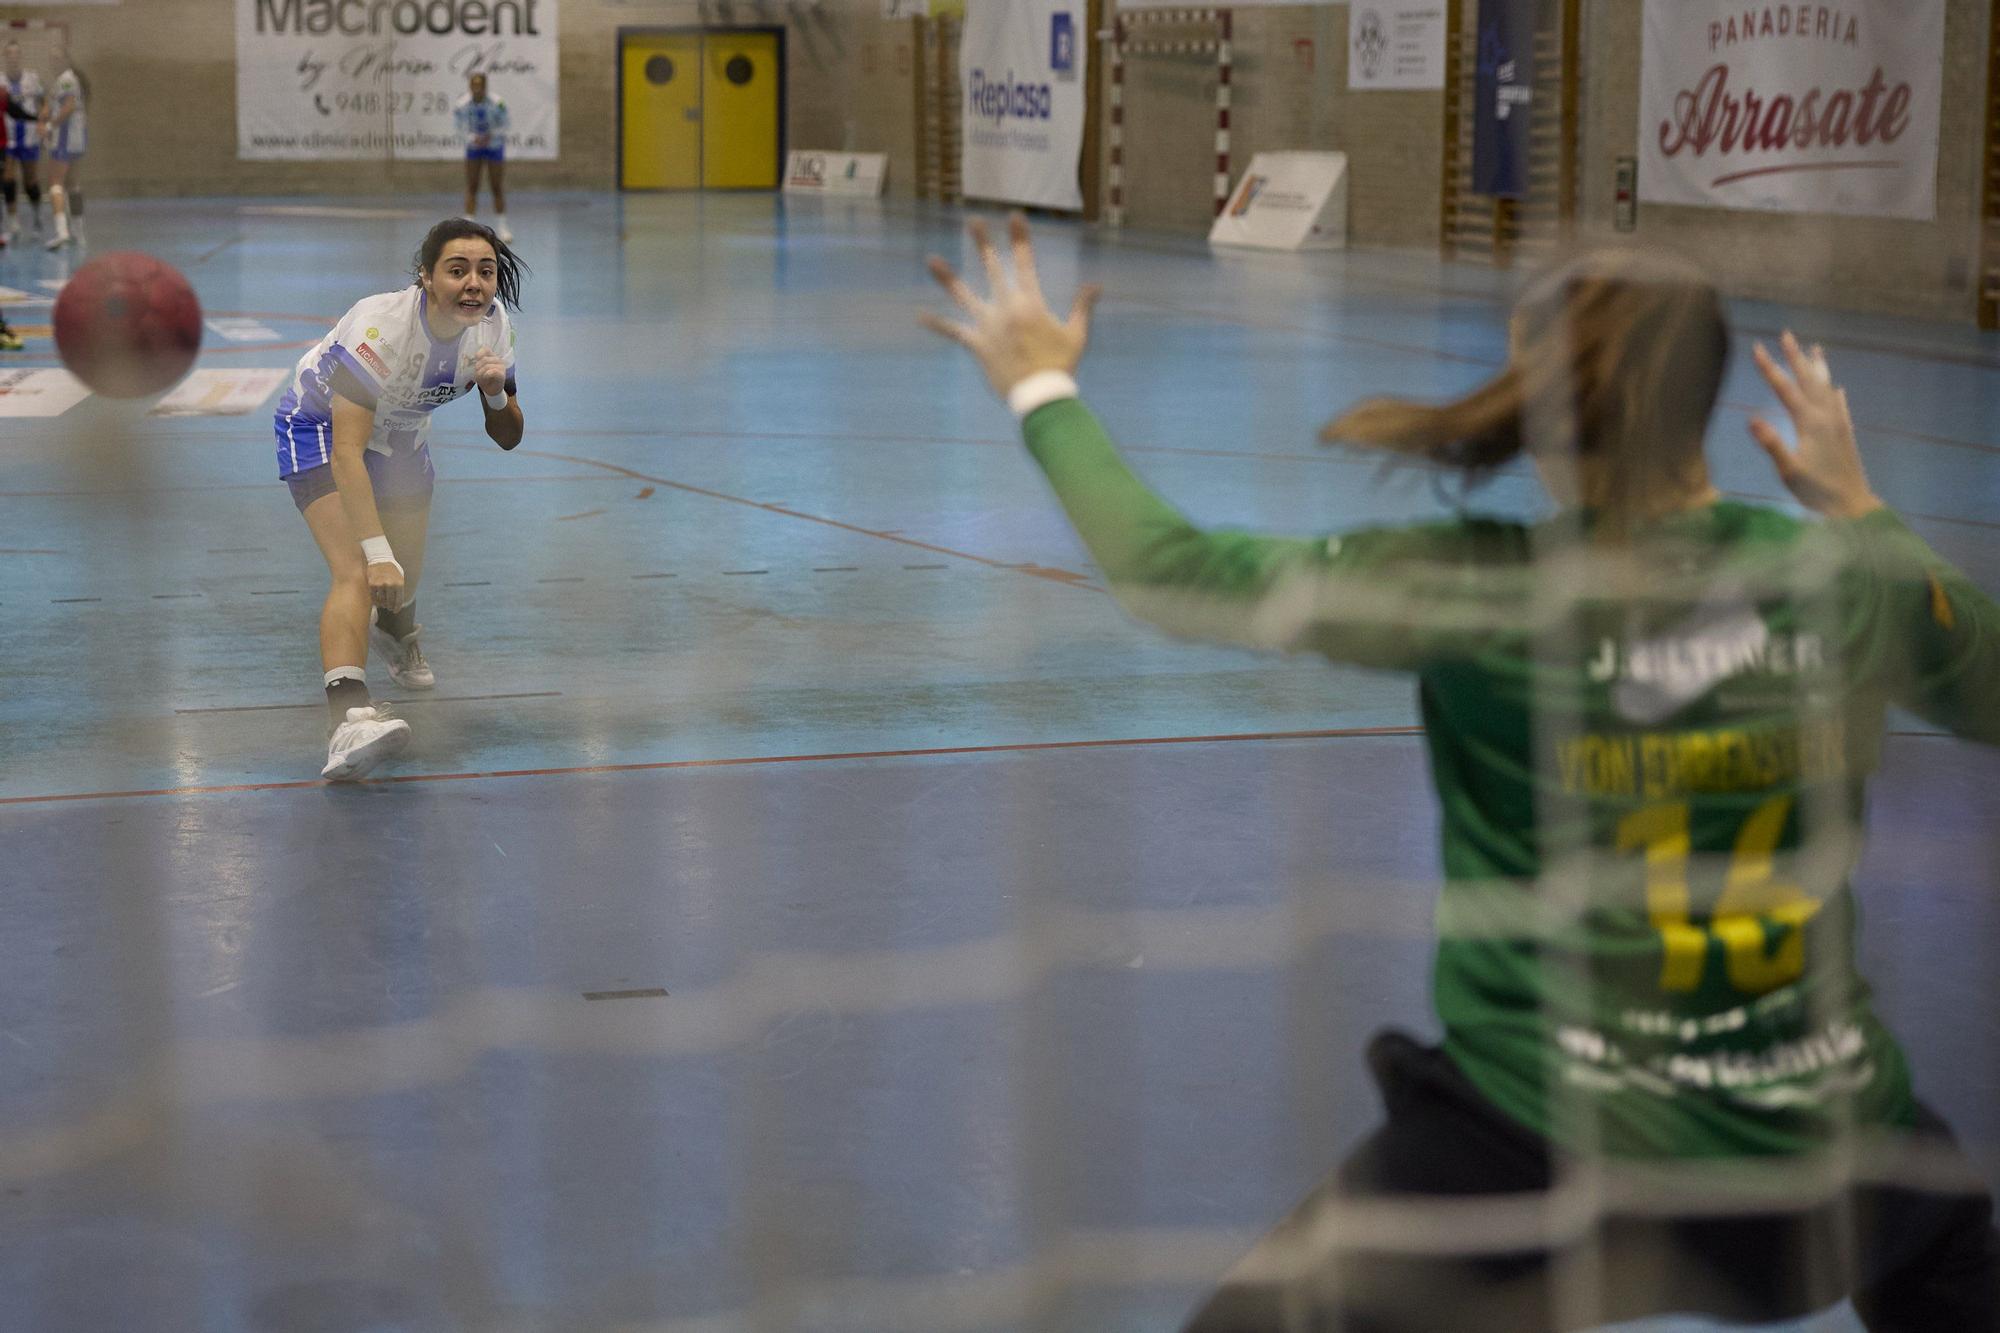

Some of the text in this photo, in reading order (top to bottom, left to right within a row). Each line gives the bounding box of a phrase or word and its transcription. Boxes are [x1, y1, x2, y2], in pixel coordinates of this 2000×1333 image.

[254, 0, 539, 36] Macrodent
[1708, 4, 1859, 50] PANADERIA
[969, 68, 1051, 127] Replasa
[1659, 62, 1912, 158] Arrasate
[1616, 796, 1823, 996] 16
